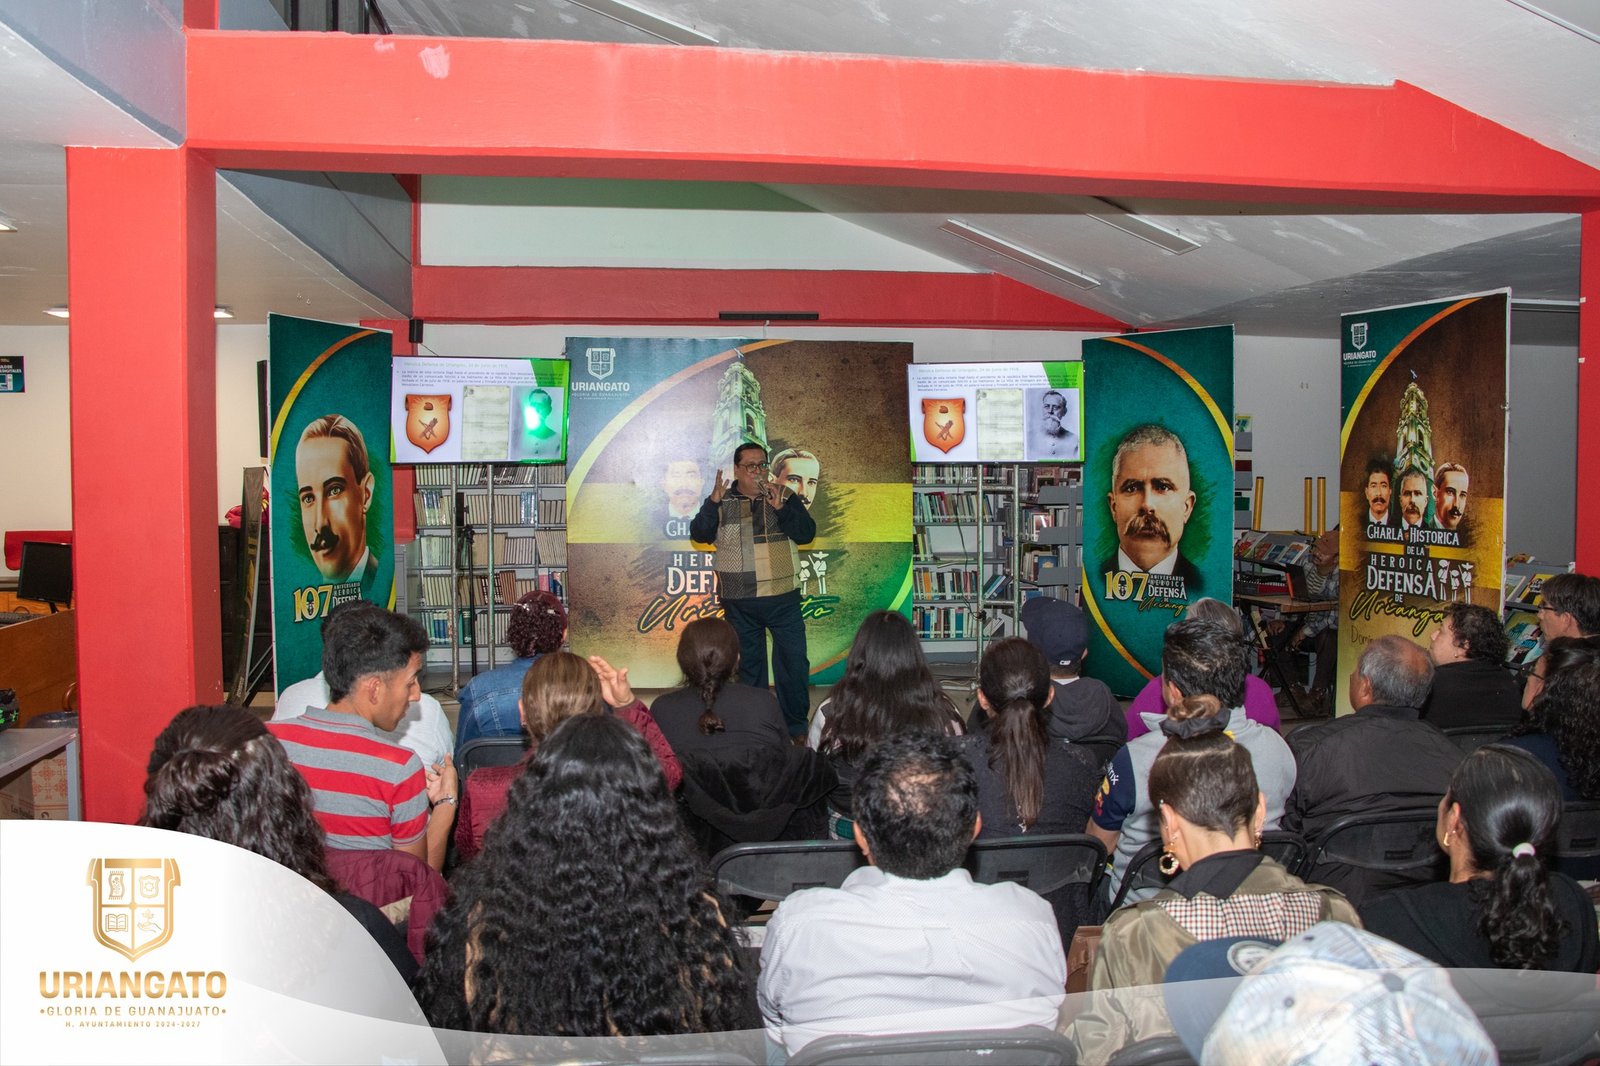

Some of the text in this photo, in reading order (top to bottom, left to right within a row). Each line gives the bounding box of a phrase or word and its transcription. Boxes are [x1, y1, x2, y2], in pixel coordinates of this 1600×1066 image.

[1343, 351, 1377, 360] URIANGATO
[571, 382, 630, 392] URIANGATO
[1366, 524, 1460, 546] CHARLA HISTORICA
[1406, 546, 1425, 556] DE LA
[1370, 554, 1433, 572] HEROICA
[1105, 570, 1149, 602] 107
[1150, 580, 1184, 588] HEROICA
[1366, 565, 1437, 599] DEFENSA
[334, 588, 361, 596] HEROICA
[1148, 585, 1187, 600] DEFENSA
[1394, 593, 1404, 603] DE
[294, 585, 333, 622] 107
[1139, 596, 1187, 617] Uriang
[1349, 590, 1446, 637] Urianga
